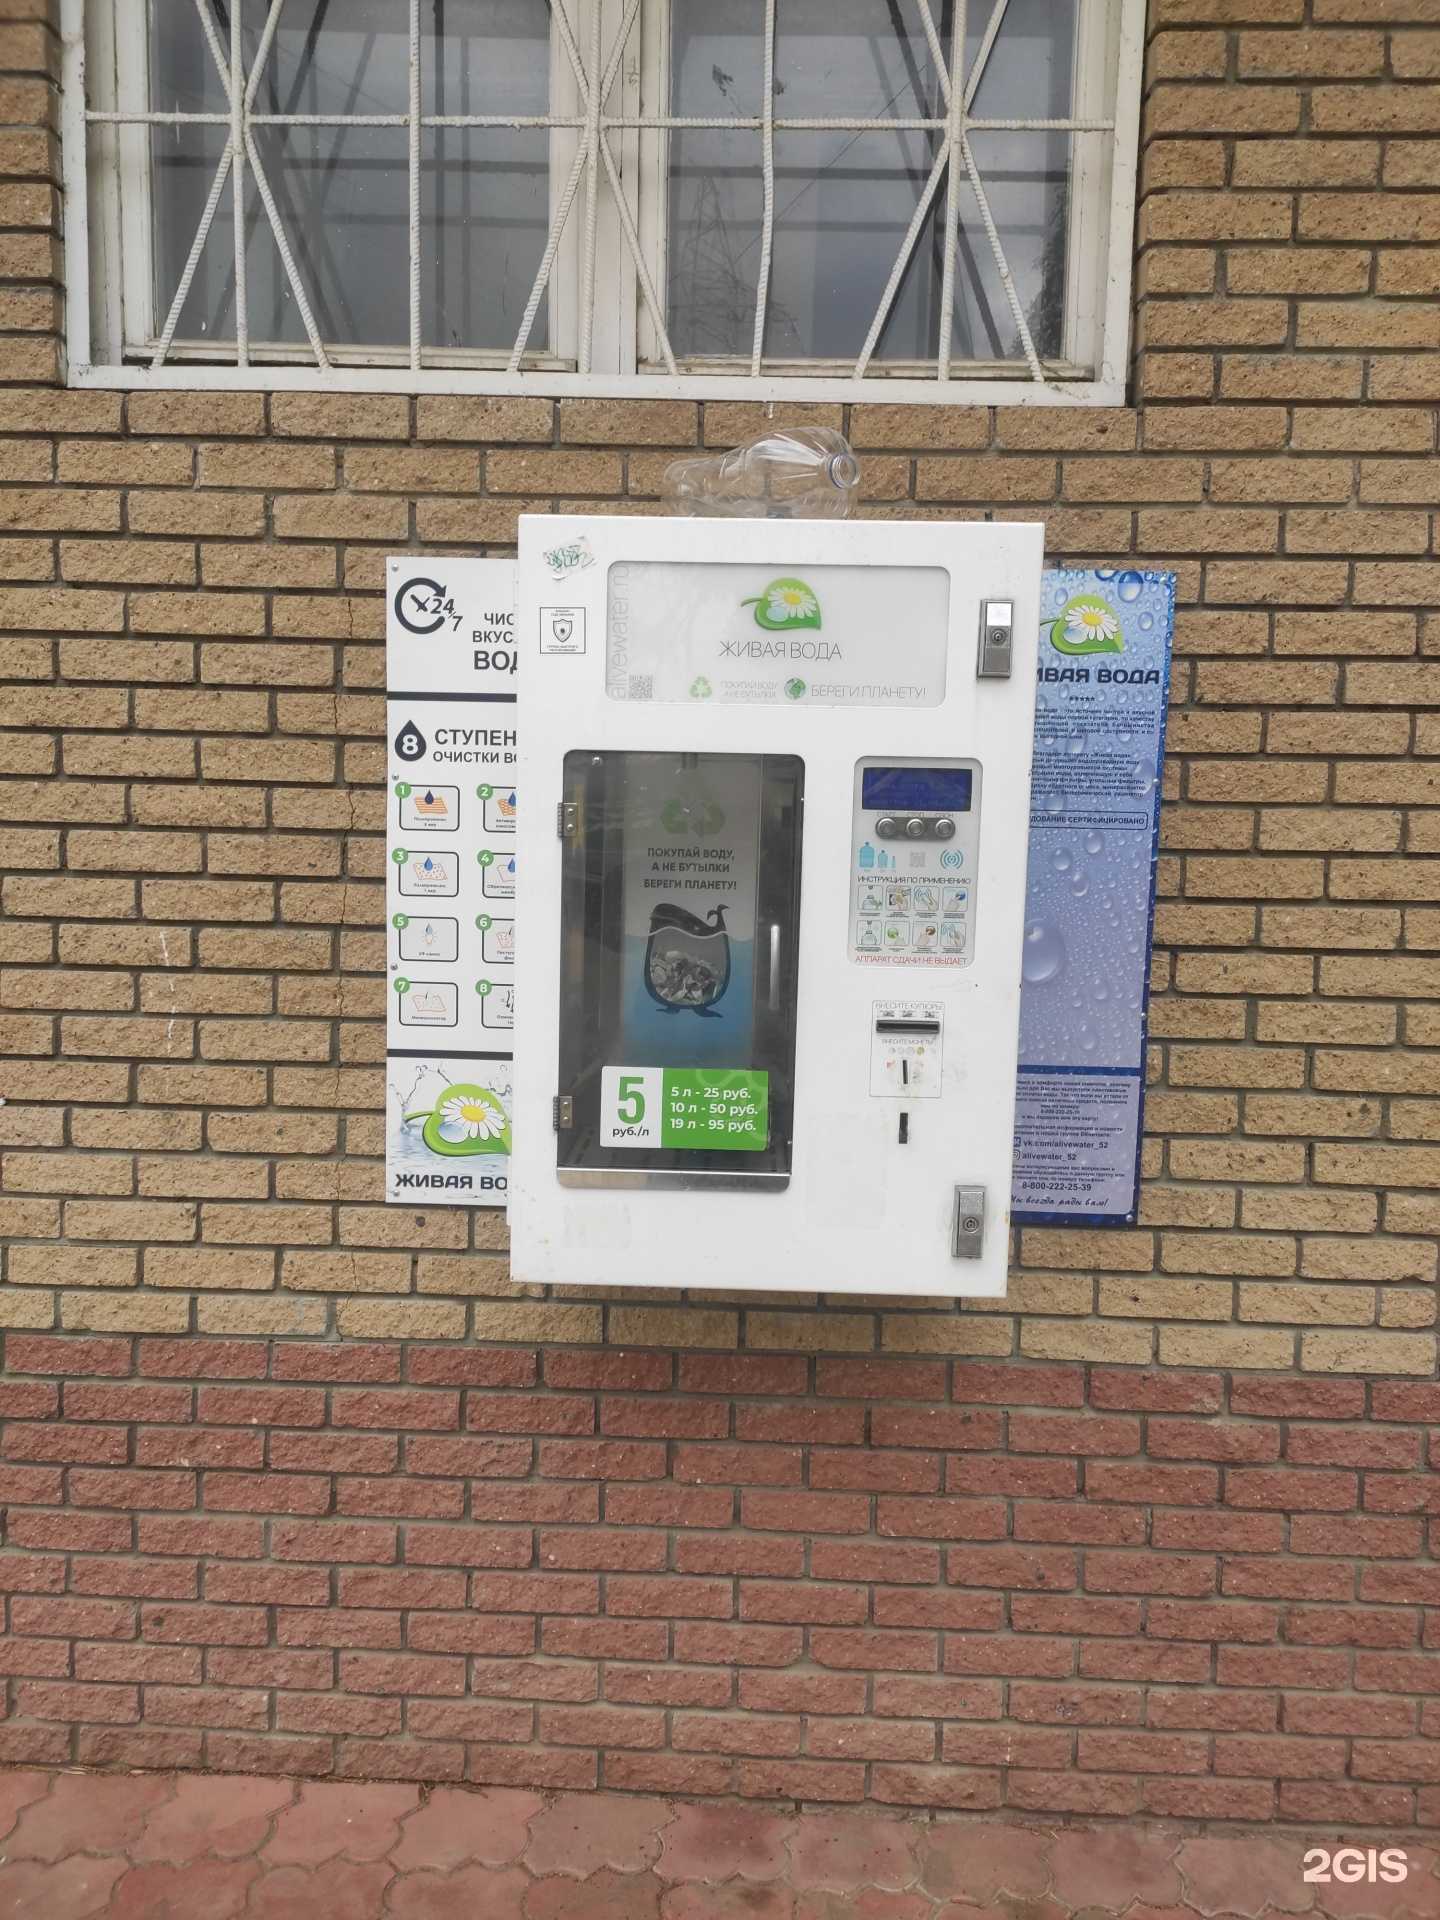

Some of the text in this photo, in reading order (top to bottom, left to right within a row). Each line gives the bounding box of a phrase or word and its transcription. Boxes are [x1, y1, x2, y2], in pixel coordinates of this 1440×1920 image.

[719, 640, 842, 661] ЖИВАЯ ВОДА
[1097, 669, 1159, 684] ВОДА
[811, 685, 928, 699] БЕРЕГИ ПЛАНЕТУ!
[401, 734, 419, 755] 8
[433, 751, 499, 763] ОЧИСТКИ
[1067, 816, 1145, 825] СЕРТИФИЦИРОВАНО
[647, 846, 735, 860] ПОКУПАЙ ВОДУ,
[651, 862, 730, 872] А НЕ БУТЫЛКИ
[643, 879, 737, 890] БЕРЕГИ ПЛАНЕТУ!
[857, 876, 906, 884] ИНСТРУКЦИЯ
[919, 877, 971, 885] ПРИМЕНЕНИЮ
[856, 955, 967, 966] АППАРАТ СДАЧИ НЕ ВЫДАЕТ
[617, 1076, 646, 1124] 5
[671, 1087, 679, 1097] 5
[682, 1088, 692, 1097] л
[703, 1088, 719, 1098] 25
[723, 1088, 752, 1100] руб.
[671, 1102, 685, 1113] 10
[688, 1104, 697, 1113] л
[709, 1104, 726, 1114] 50
[729, 1104, 758, 1117] руб.
[612, 1126, 650, 1138] руб./л
[671, 1118, 684, 1129] 19
[687, 1120, 696, 1129] л
[708, 1120, 725, 1130] 95
[728, 1120, 757, 1133] руб.
[1023, 1140, 1109, 1150] vk.com/alivewater_52
[396, 1174, 473, 1189] ЖИВАЯ
[1022, 1182, 1092, 1191] 8-800-222-25-39
